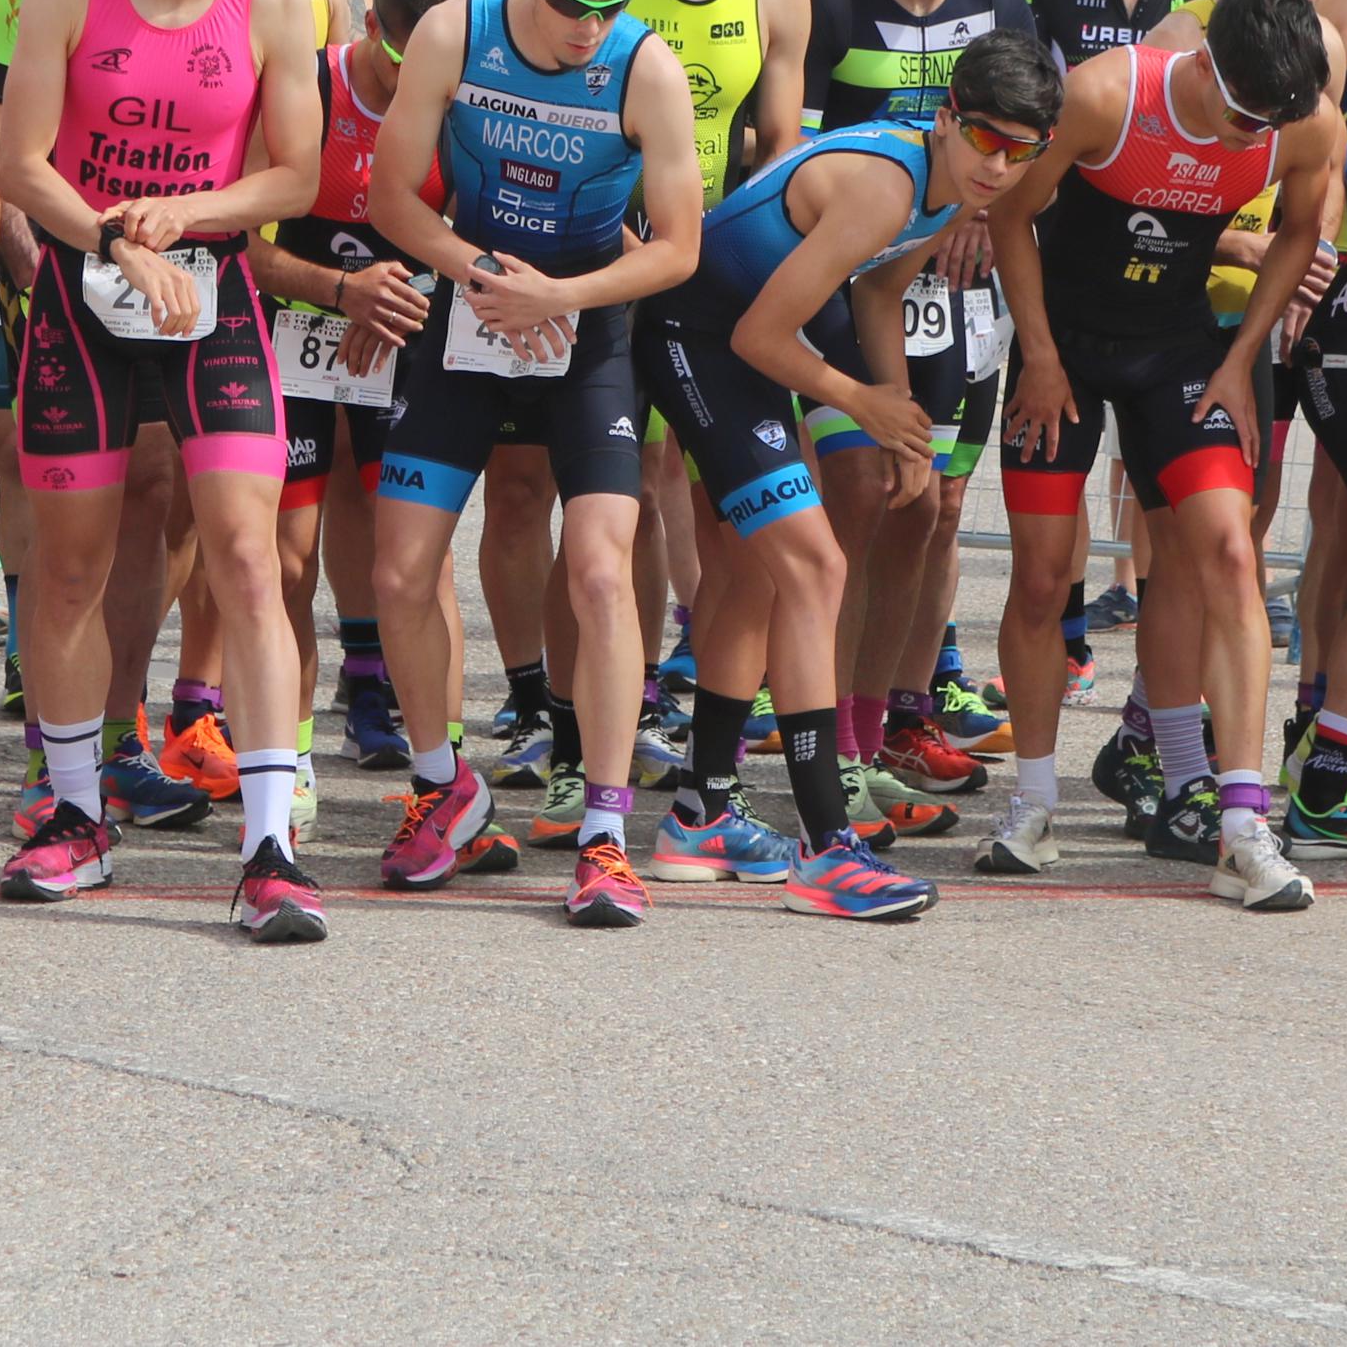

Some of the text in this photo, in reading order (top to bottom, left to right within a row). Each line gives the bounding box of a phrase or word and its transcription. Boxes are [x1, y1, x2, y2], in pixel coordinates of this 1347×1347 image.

[108, 96, 191, 133] GIL
[468, 93, 538, 120] LAGUNA
[546, 111, 608, 131] DUERO
[89, 131, 210, 173] Triatlón
[482, 118, 585, 164] MARCOS
[506, 162, 553, 188] INGLAGO
[1132, 187, 1223, 214] CORREA
[491, 205, 557, 234] VOICE
[1137, 234, 1189, 250] Diputación
[1148, 243, 1174, 254] Soria
[682, 383, 709, 429] DUERO
